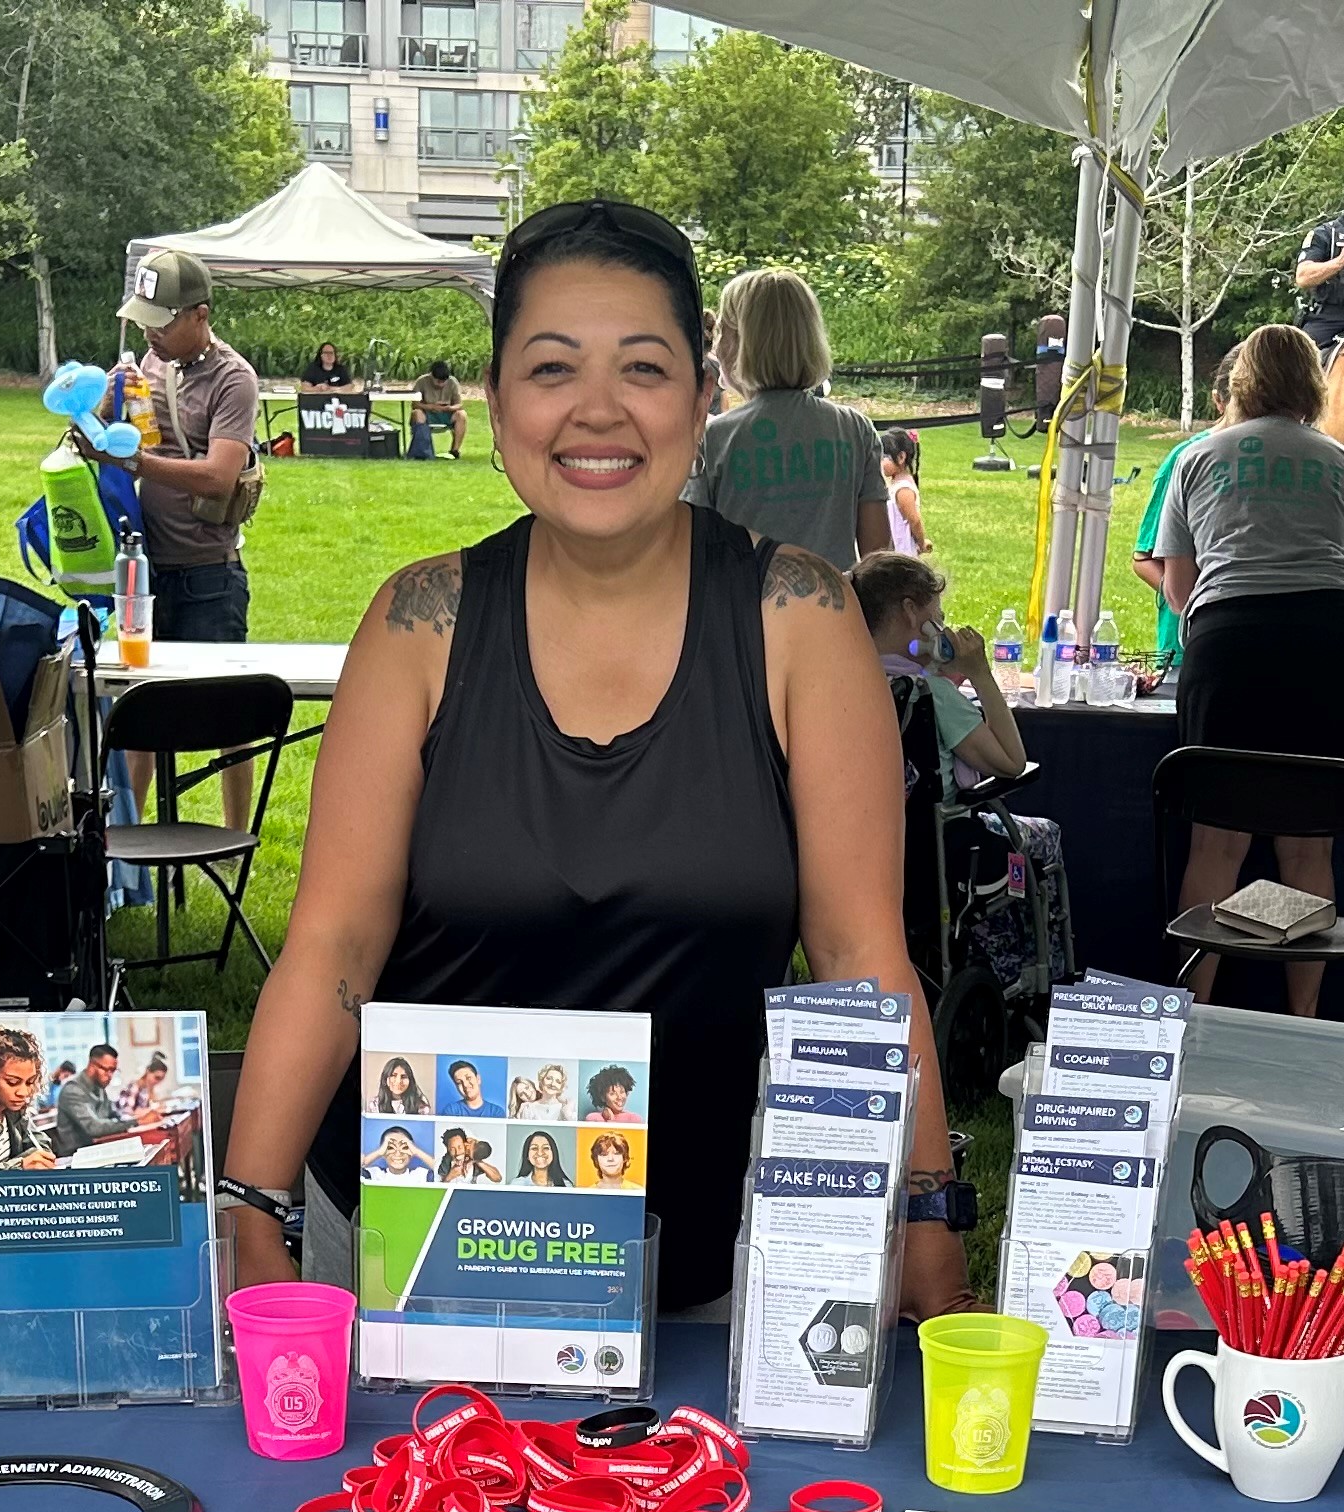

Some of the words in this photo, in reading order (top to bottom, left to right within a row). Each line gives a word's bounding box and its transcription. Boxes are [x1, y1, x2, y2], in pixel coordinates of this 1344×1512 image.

[301, 398, 366, 434] VICTORY
[793, 995, 878, 1009] METHAMPHETAMINE
[1053, 992, 1113, 1003] PRESCRIPTION
[1081, 1001, 1105, 1011] DRUG
[1107, 1003, 1138, 1012] MISUSE
[798, 1045, 848, 1057] MARIJUANA
[1063, 1054, 1110, 1066] COCAINE
[1036, 1103, 1116, 1117] DRUG-IMPAIRED
[1034, 1116, 1077, 1127] DRIVING
[1022, 1155, 1053, 1167] MDMA,
[1055, 1158, 1094, 1169] ECSTASY,
[1022, 1164, 1029, 1172] &
[1030, 1165, 1060, 1174] MOLLY
[773, 1170, 812, 1186] FAKE
[817, 1173, 856, 1189] PILLS
[49, 1182, 90, 1196] WITH
[93, 1180, 162, 1194] PURPOSE:
[38, 1201, 87, 1211] PLANNING
[88, 1200, 117, 1210] GUIDE
[118, 1199, 137, 1209] FOR
[58, 1215, 85, 1225] DRUG
[86, 1214, 119, 1224] MISUSE
[32, 1230, 75, 1240] COLLEGE
[76, 1228, 124, 1238] STUDENTS
[457, 1218, 562, 1239] GROWING
[567, 1222, 595, 1240] UP
[457, 1237, 537, 1263] DRUG
[546, 1242, 626, 1266] FREE:
[283, 1396, 304, 1410] US
[60, 1463, 166, 1500] ADMINISTRATION
